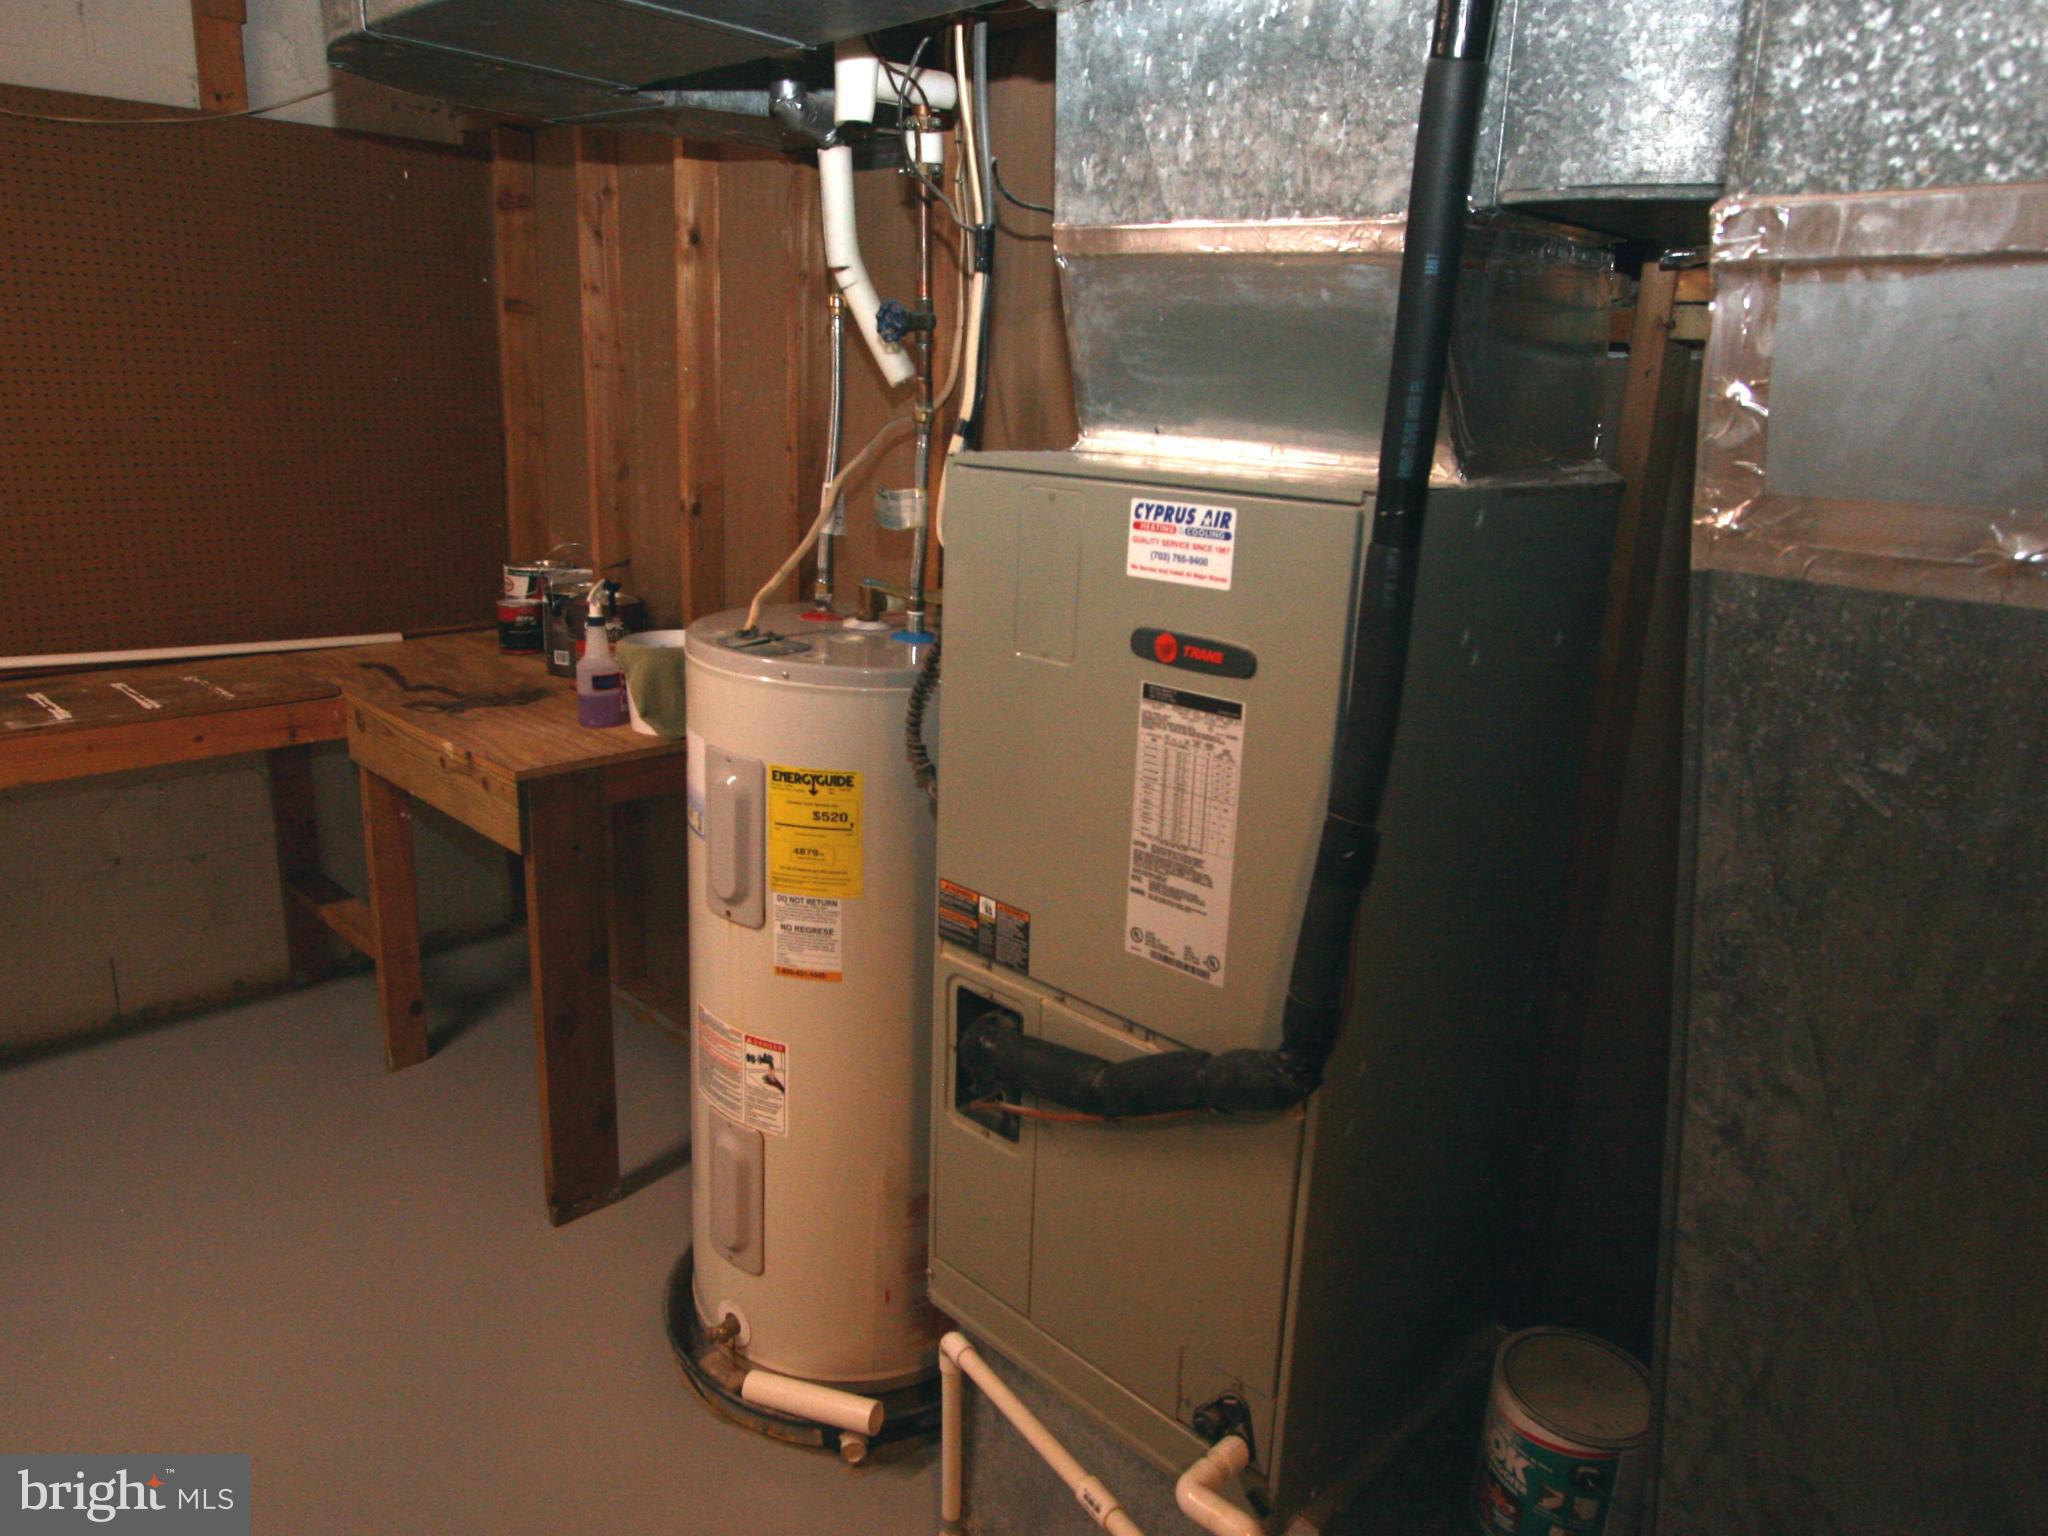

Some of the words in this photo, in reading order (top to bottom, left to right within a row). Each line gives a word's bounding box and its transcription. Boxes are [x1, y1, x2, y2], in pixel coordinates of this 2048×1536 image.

[1134, 503, 1197, 525] CYPRUS
[1201, 509, 1232, 529] AIR
[1140, 521, 1175, 534] HEATING
[1186, 527, 1225, 540] COOLING
[1132, 535, 1160, 546] QUALITY
[1162, 539, 1190, 550] SERVICE
[1192, 543, 1213, 553] SINCE
[772, 770, 855, 789] ENERGYGUIDE
[812, 811, 848, 823] $520
[776, 895, 788, 903] DO
[789, 896, 805, 905] NOT
[806, 898, 838, 907] RETURN
[780, 923, 792, 932] NO
